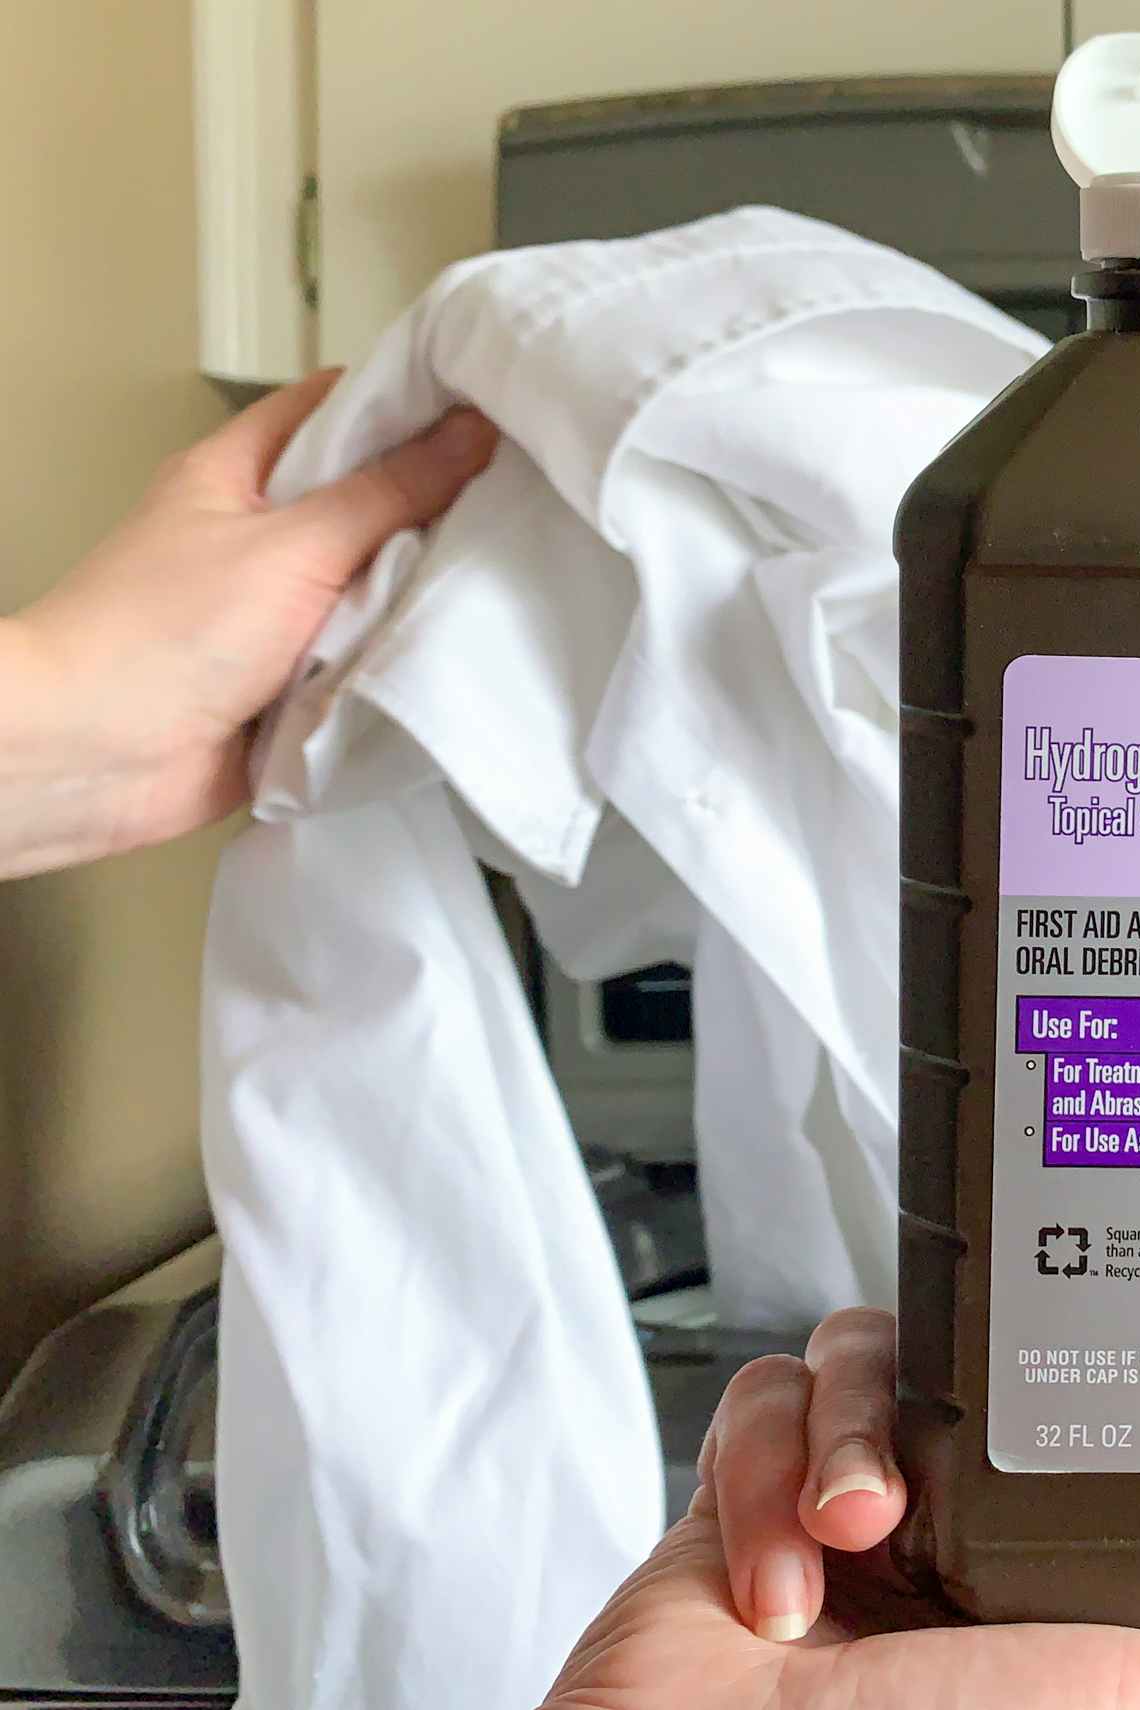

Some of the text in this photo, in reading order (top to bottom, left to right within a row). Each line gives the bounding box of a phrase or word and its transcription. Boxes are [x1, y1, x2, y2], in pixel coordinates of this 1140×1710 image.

[1047, 795, 1135, 844] Topical
[1016, 909, 1077, 938] FIRST
[1082, 910, 1121, 939] AID
[1015, 946, 1074, 975] ORAL
[1032, 1009, 1118, 1040] Use For:
[1053, 1058, 1082, 1084] For
[1052, 1090, 1085, 1116] and
[1052, 1127, 1080, 1152] For
[1085, 1127, 1119, 1152] Use
[1106, 1243, 1134, 1258] than
[1018, 1349, 1041, 1365] DO
[1046, 1350, 1079, 1366] NOT
[1084, 1350, 1117, 1366] USE
[1121, 1350, 1136, 1366] IF
[1024, 1368, 1081, 1384] UNDER
[1086, 1369, 1118, 1384] CAP
[1123, 1369, 1138, 1384] IS
[1035, 1424, 1061, 1448] 32
[1069, 1424, 1094, 1448] FL
[1102, 1424, 1133, 1448] OZ
